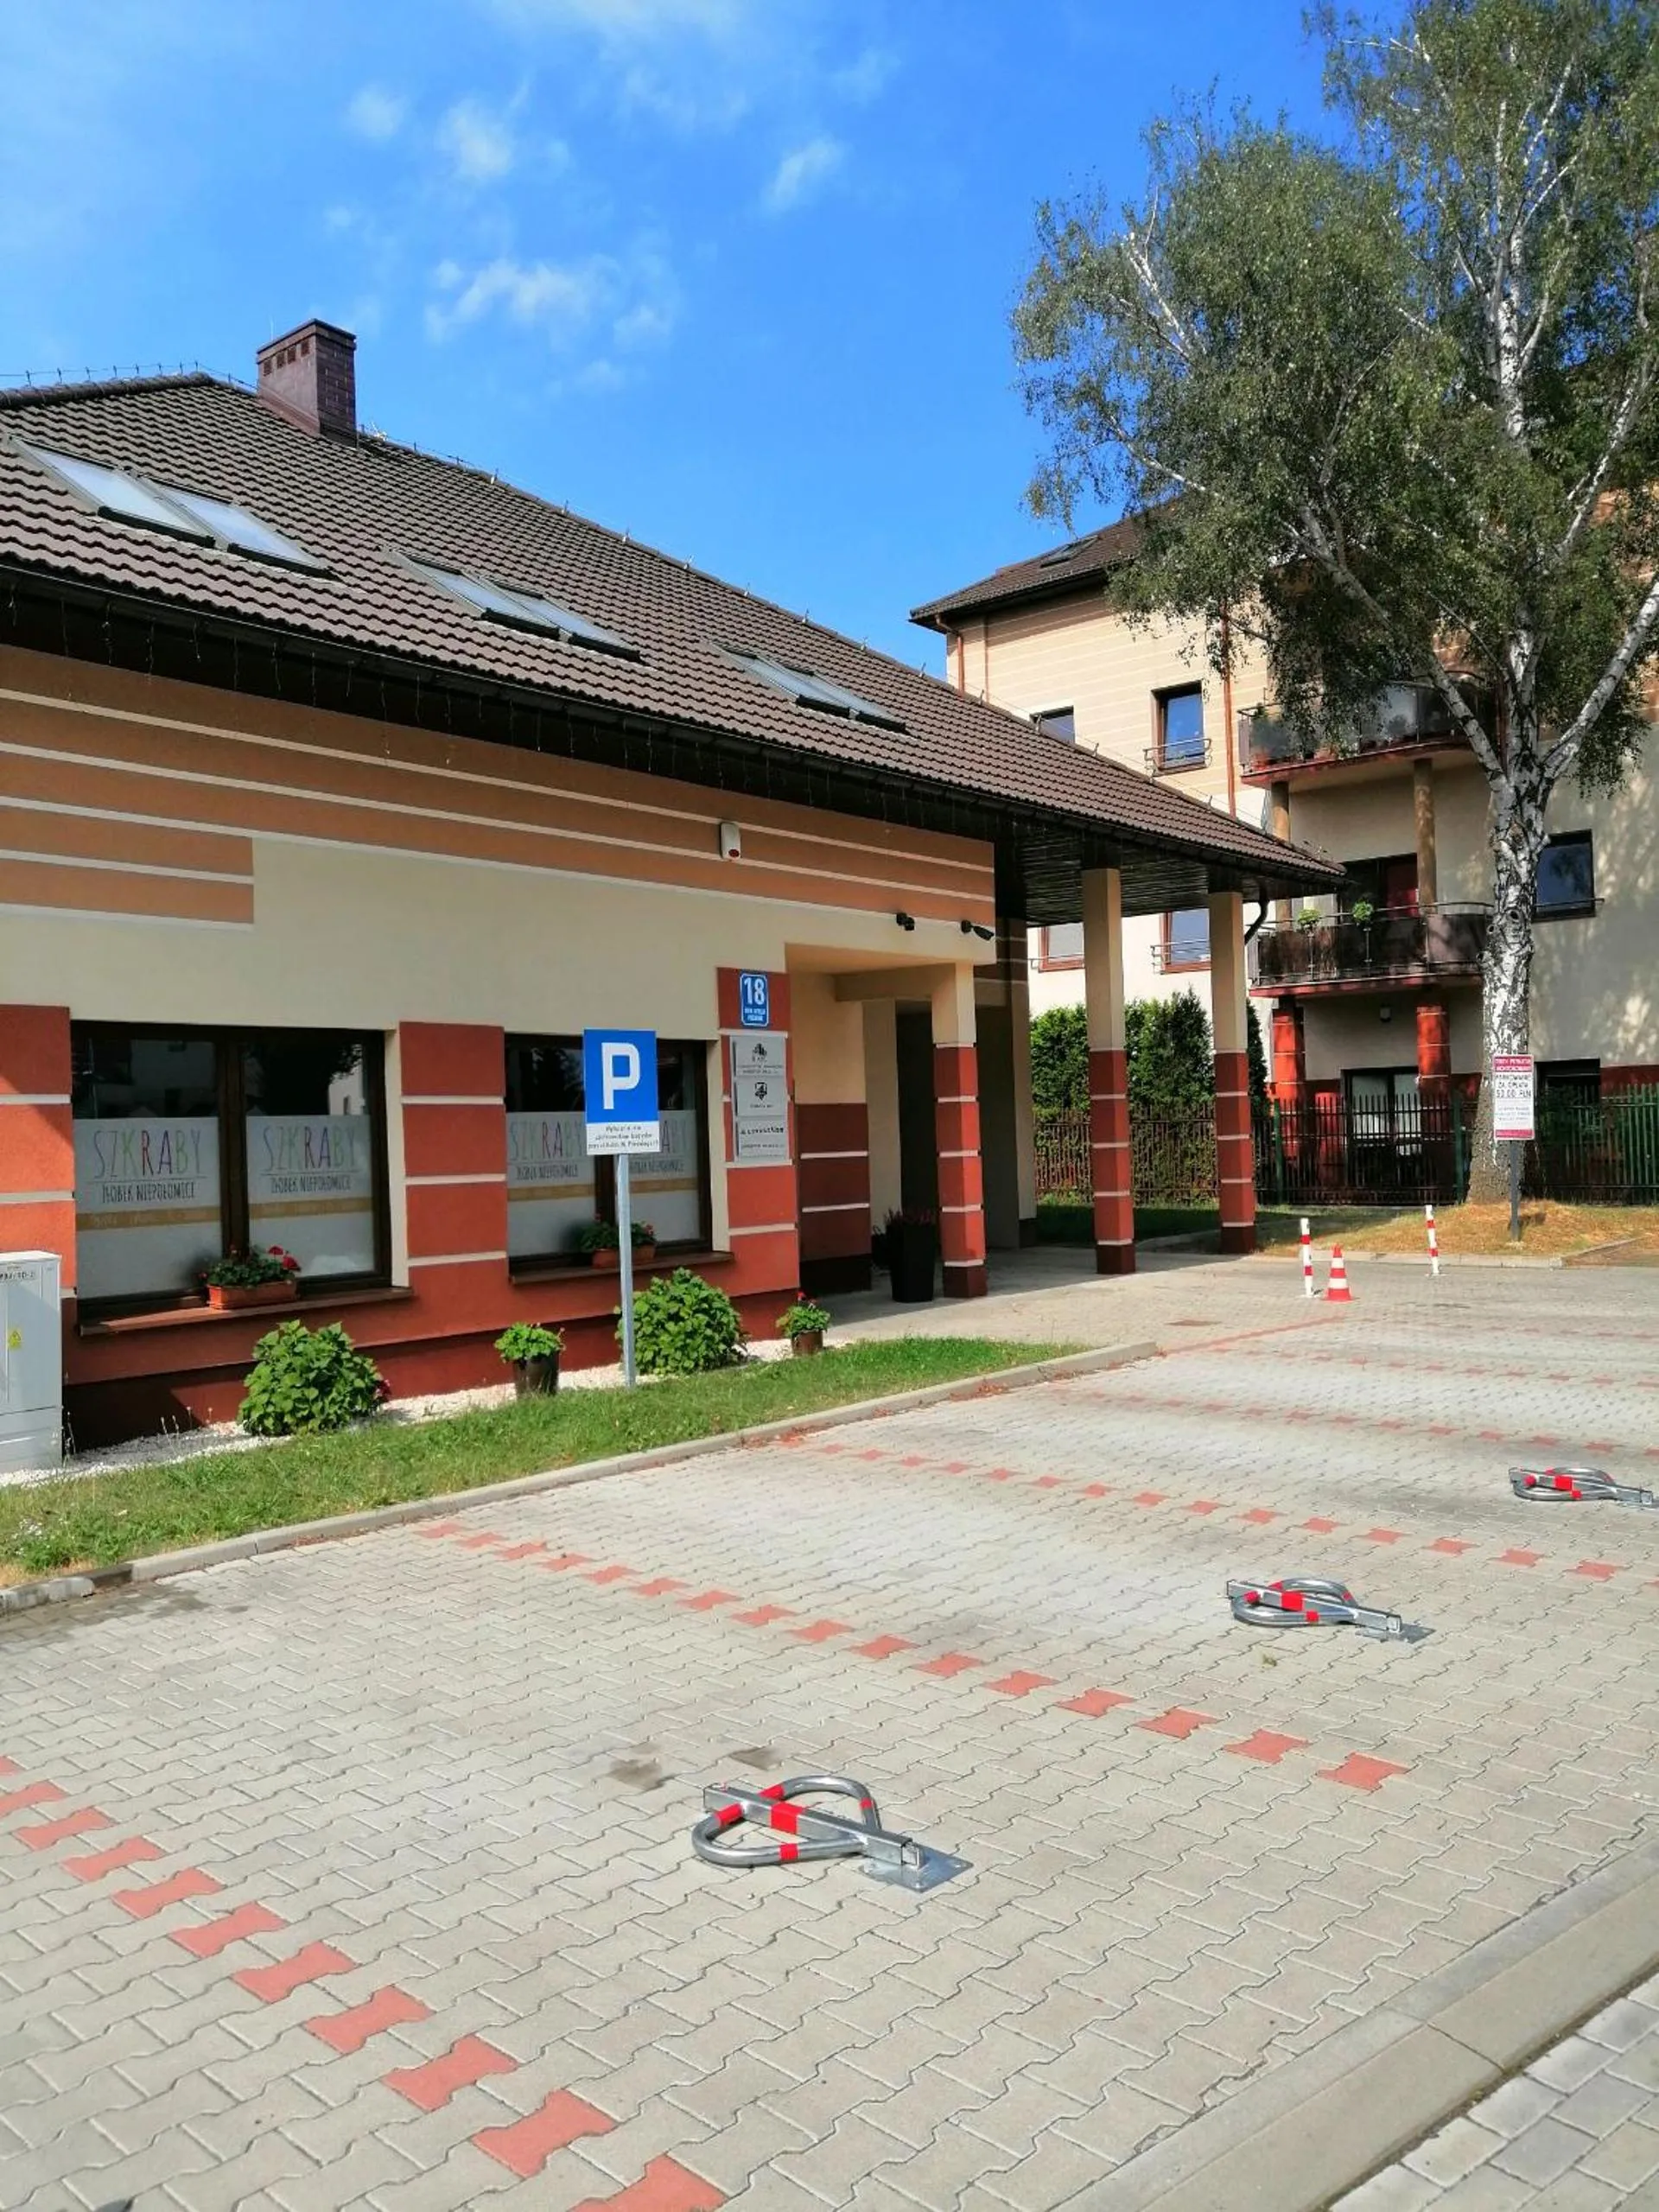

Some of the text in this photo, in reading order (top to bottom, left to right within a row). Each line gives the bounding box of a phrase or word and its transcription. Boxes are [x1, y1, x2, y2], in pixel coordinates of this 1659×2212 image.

[744, 976, 766, 1005] 18
[601, 1042, 640, 1109] P
[92, 1128, 203, 1179] SZKRABY
[262, 1125, 357, 1172] SZKRABY
